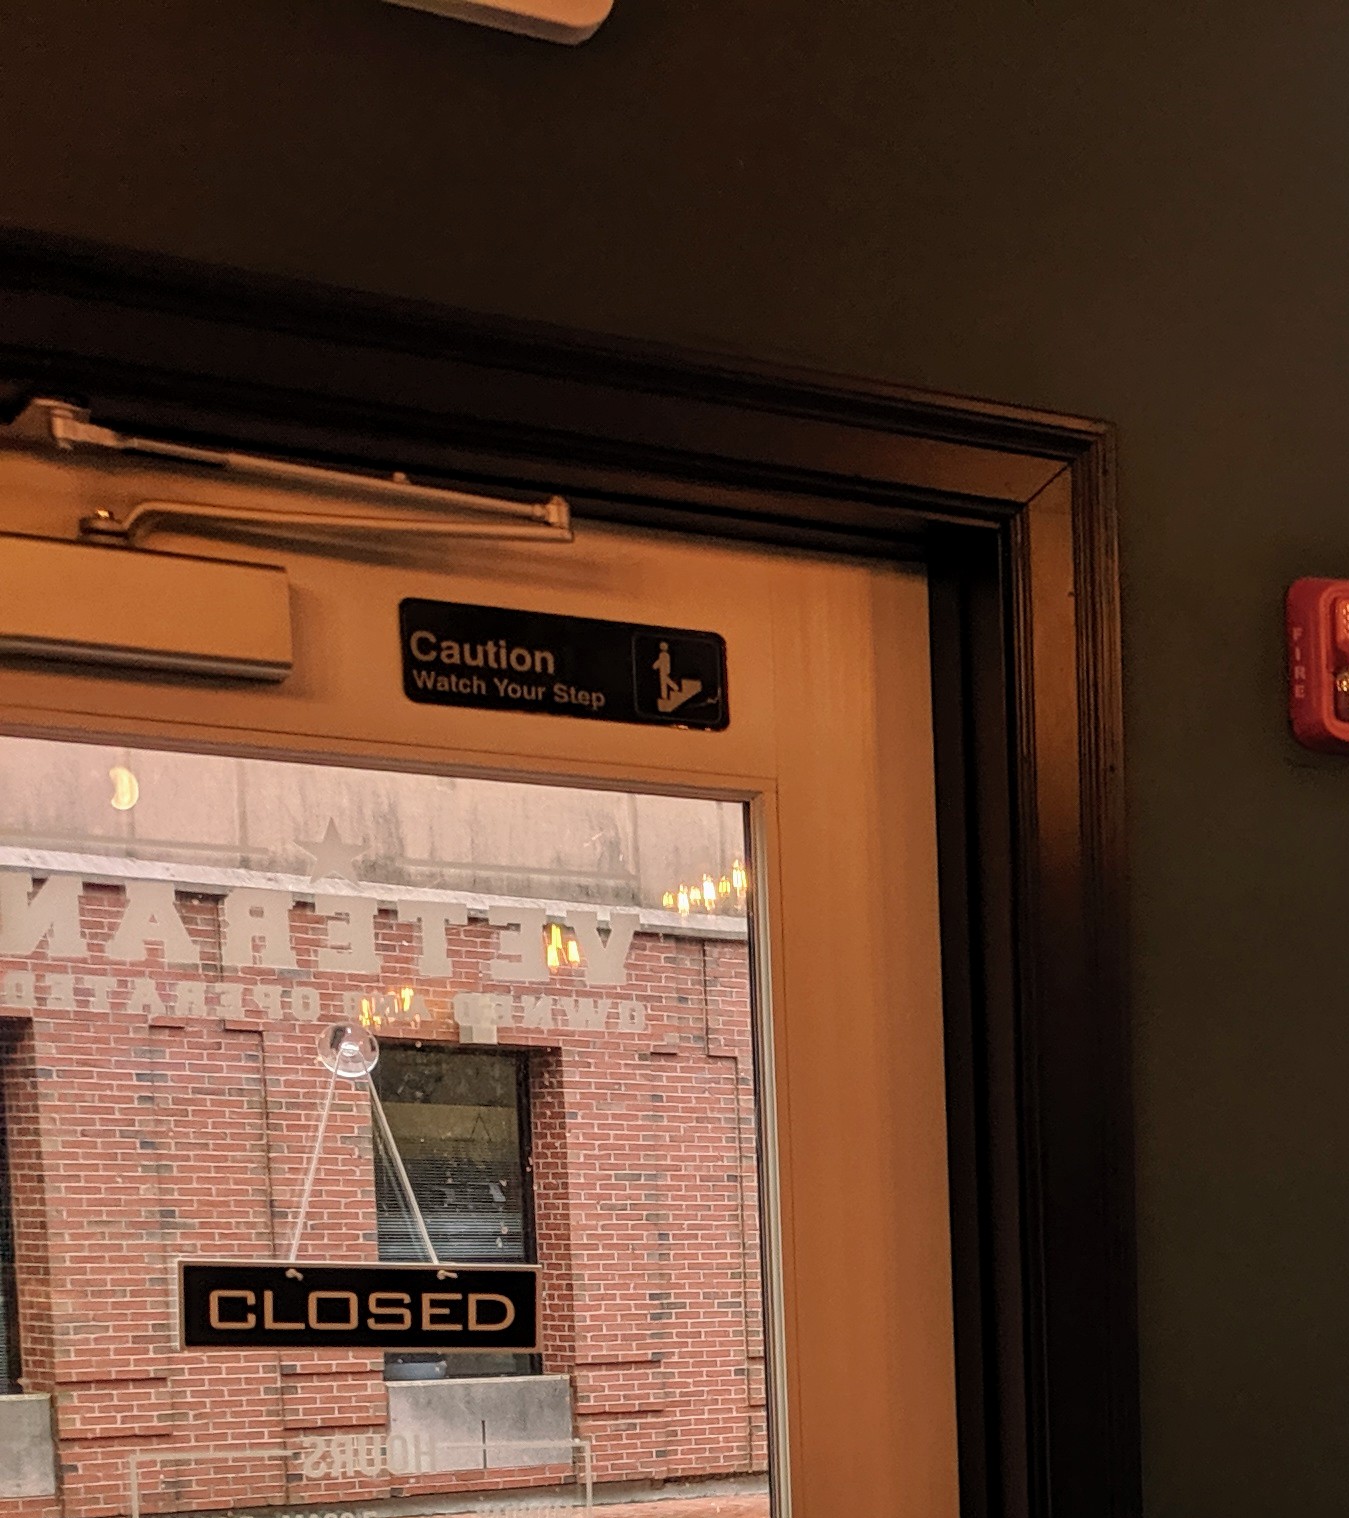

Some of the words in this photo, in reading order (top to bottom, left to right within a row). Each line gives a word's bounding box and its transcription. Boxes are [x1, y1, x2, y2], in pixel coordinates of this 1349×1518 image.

[410, 629, 556, 676] Caution
[1290, 626, 1308, 699] FIRE
[412, 669, 487, 696] Watch
[493, 677, 546, 701] Your
[553, 682, 606, 711] Step
[209, 1289, 516, 1331] CLOSED
